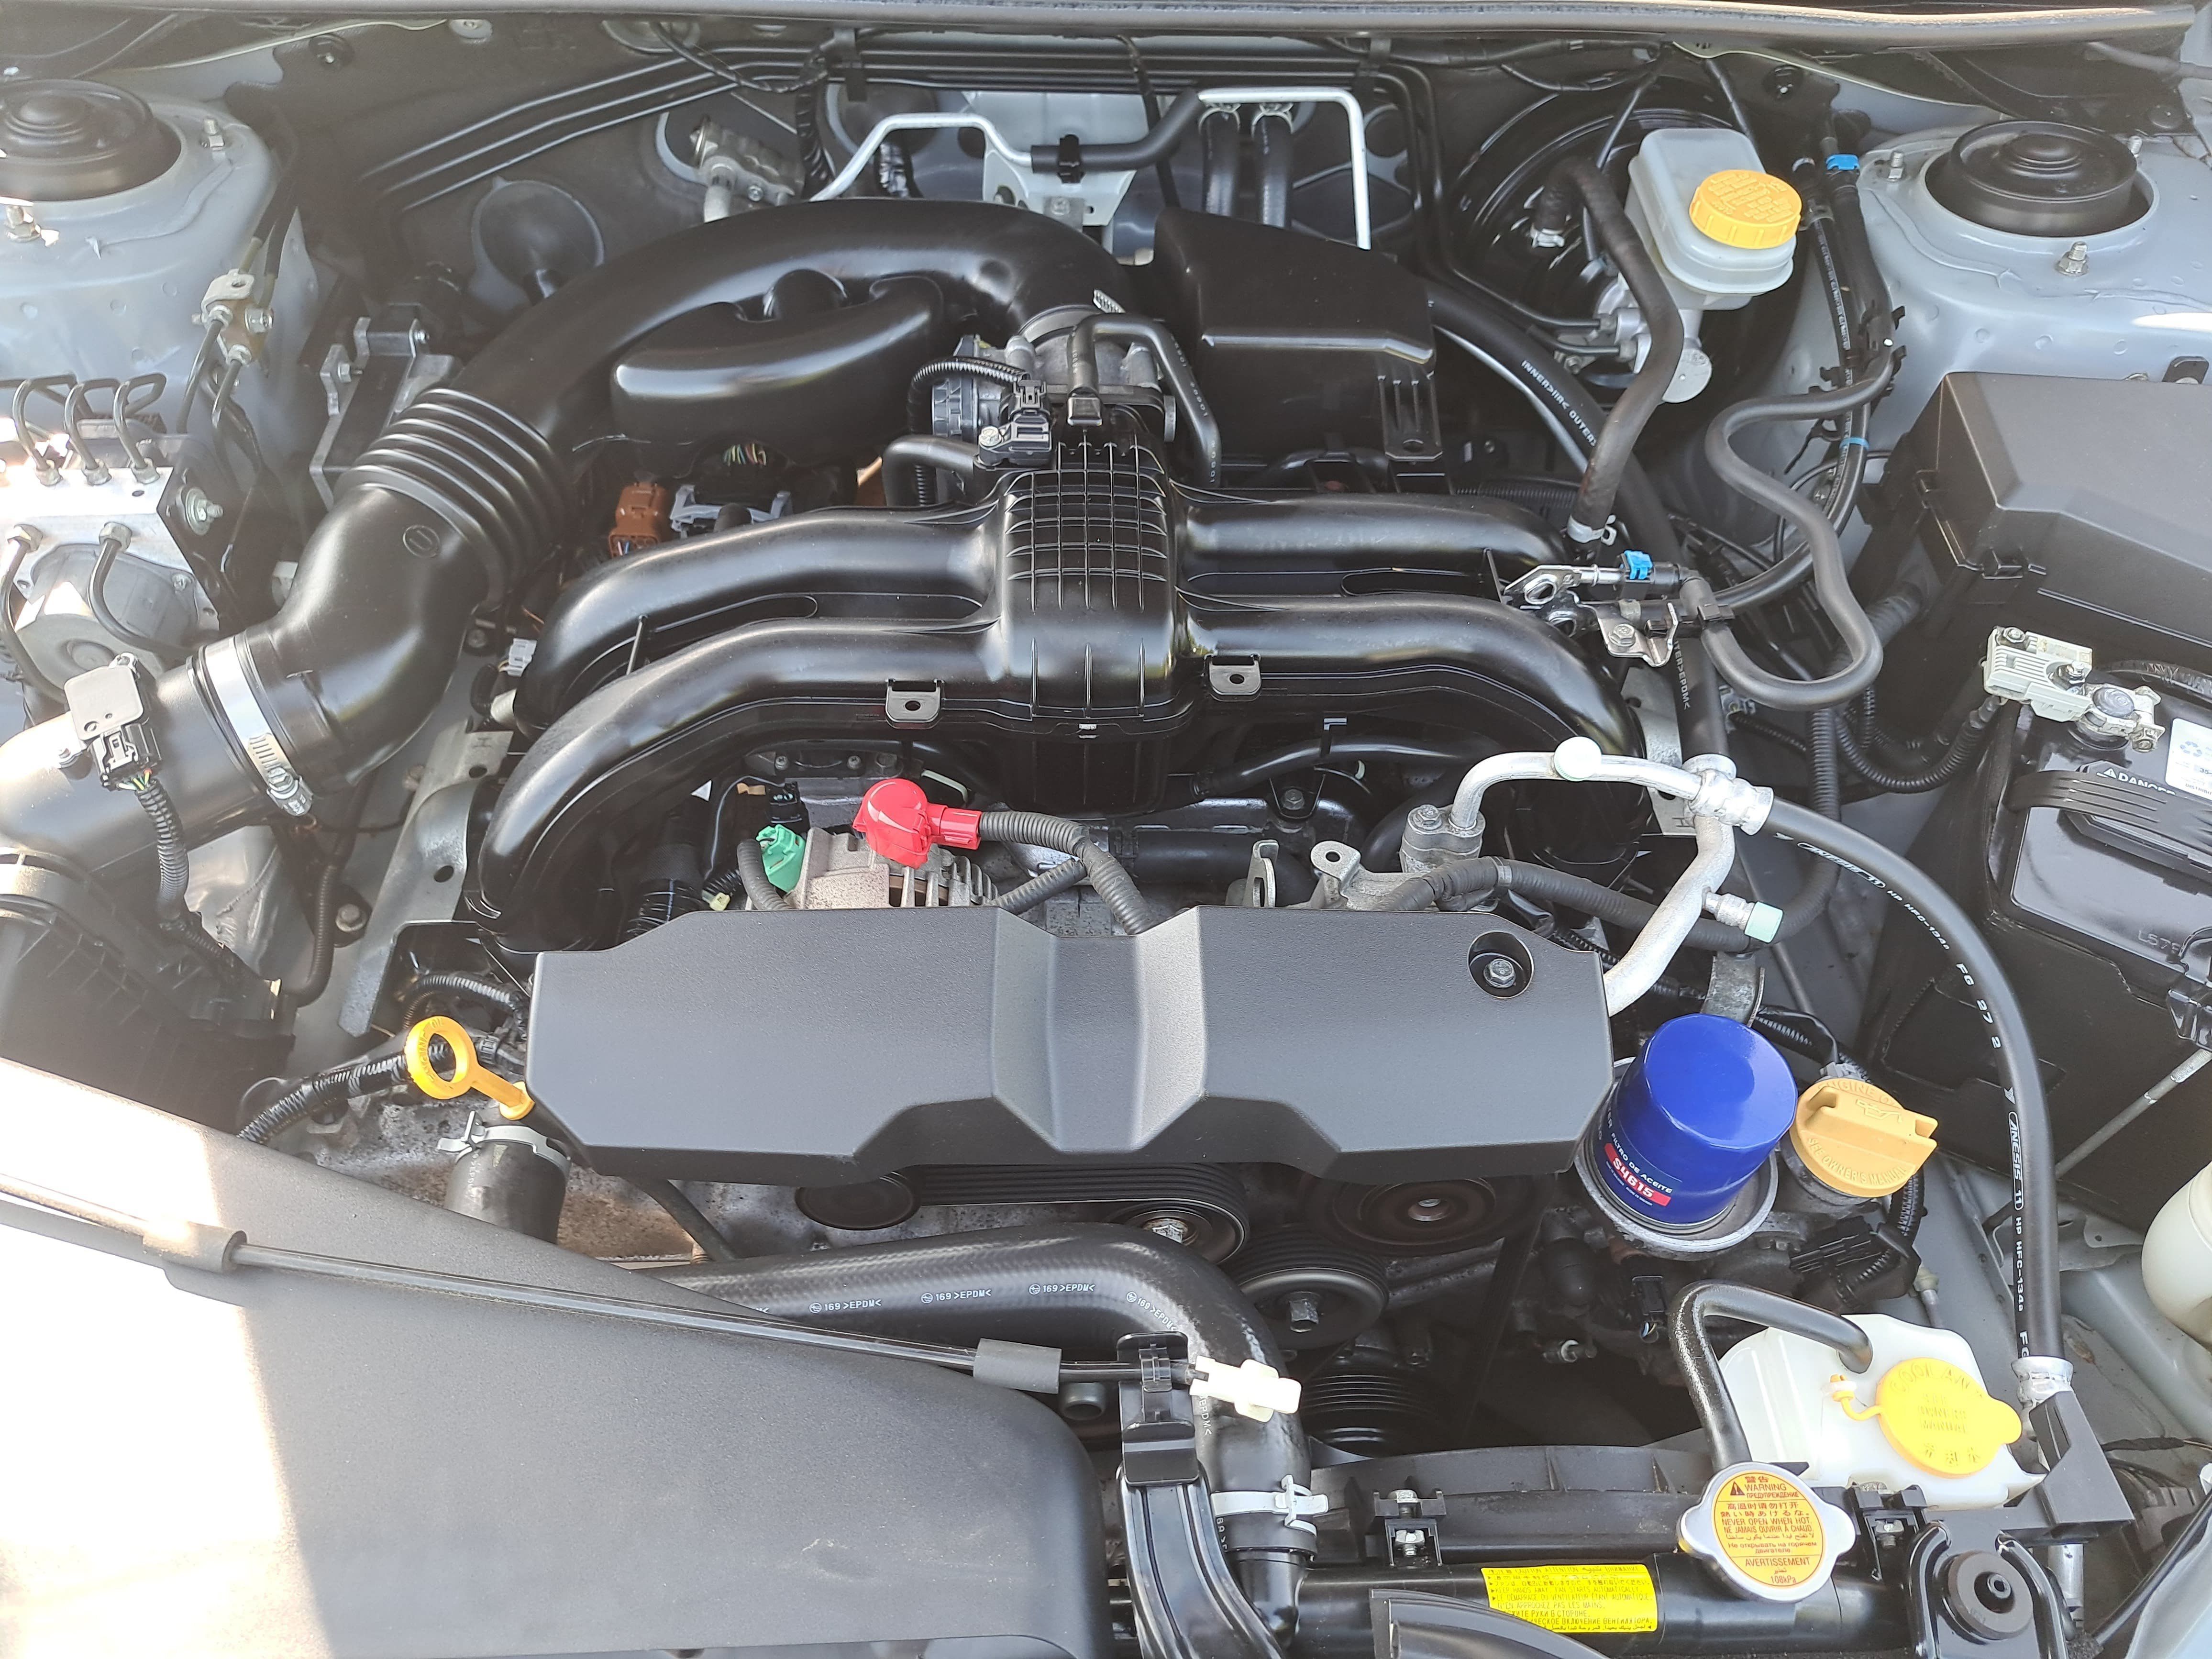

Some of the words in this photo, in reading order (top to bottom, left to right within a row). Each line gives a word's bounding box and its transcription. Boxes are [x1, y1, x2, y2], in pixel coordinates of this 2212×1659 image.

[2118, 772, 2176, 796] DAN
[1956, 963, 1975, 986] FG
[1808, 1137, 1823, 1157] SEE
[1823, 1155, 1867, 1184] OWNER'S
[1869, 1166, 1906, 1186] MANUAL
[1613, 1157, 1655, 1198] S4615
[1628, 1161, 1641, 1173] DE
[1640, 1173, 1673, 1194] ACEITE
[2015, 1217, 2022, 1235] HP
[935, 1292, 952, 1301] 169
[824, 1302, 841, 1311] 169
[1137, 1297, 1150, 1310] 169
[1744, 1483, 1787, 1492] WARNING
[1770, 1517, 1793, 1525] WHEN
[1745, 1557, 1810, 1567] AVERTISSEMENT
[1770, 1575, 1797, 1584] 108kPa
